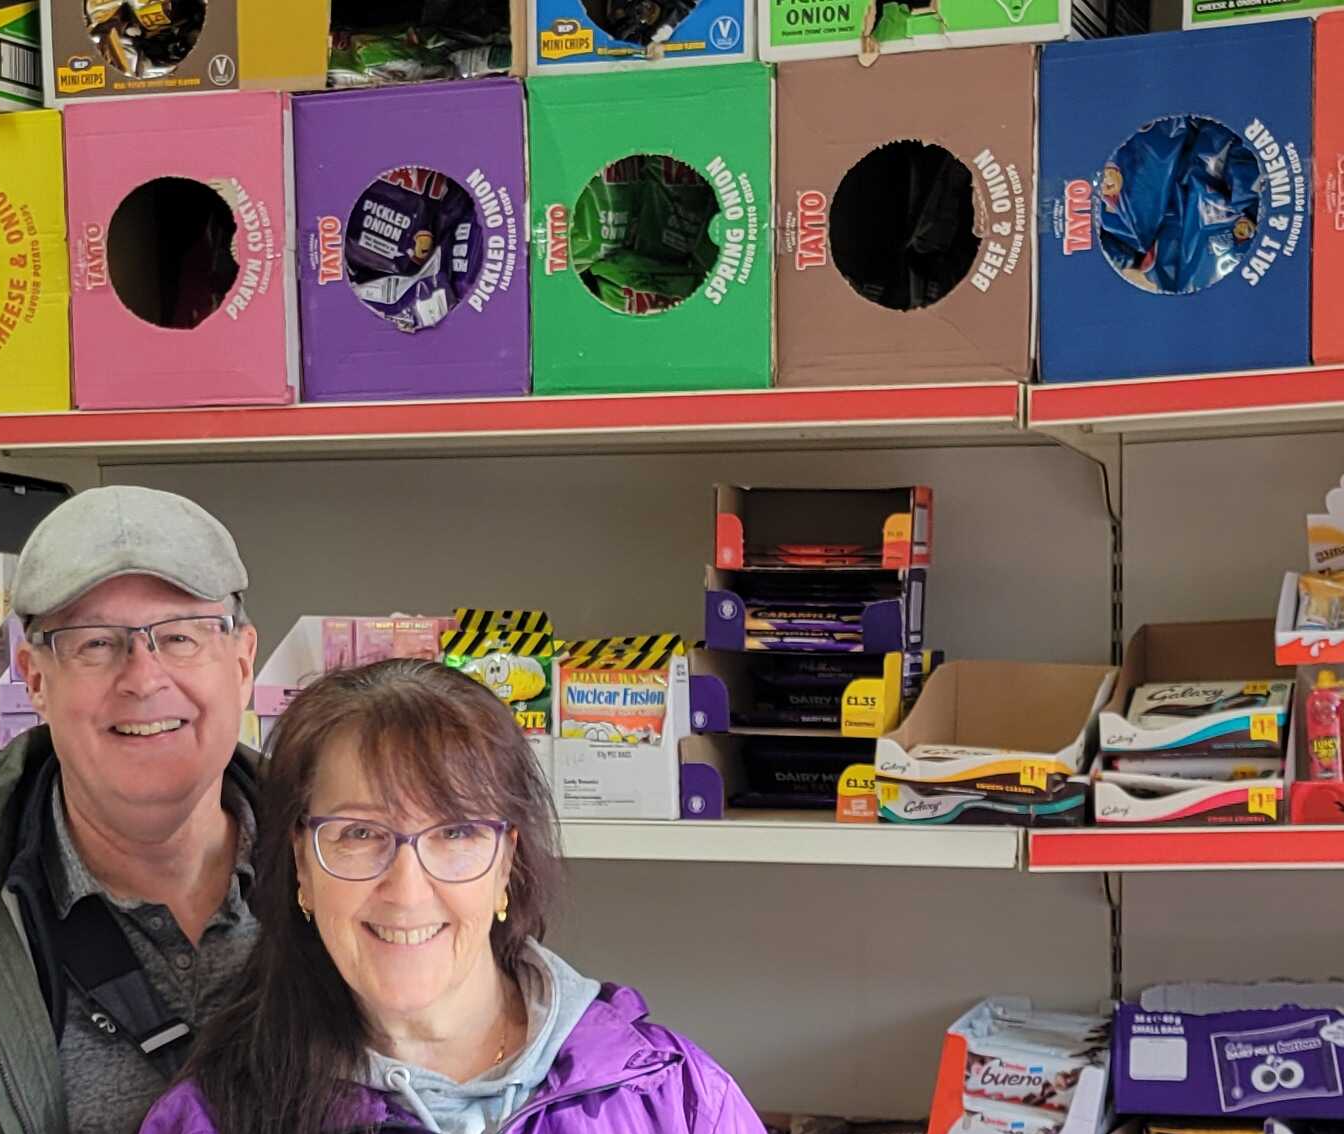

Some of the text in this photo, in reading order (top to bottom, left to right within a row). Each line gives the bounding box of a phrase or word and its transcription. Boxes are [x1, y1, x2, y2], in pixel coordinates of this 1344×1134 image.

[786, 3, 850, 27] ONION
[973, 148, 1012, 214] ONION
[1244, 118, 1292, 209] VINEGAR
[362, 200, 411, 230] PICKLED
[362, 216, 403, 242] ONION
[465, 168, 506, 313] PICKLED ONION
[545, 203, 569, 276] TAYTO
[705, 156, 745, 305] SPRING ONION
[796, 190, 827, 271] TAYTO
[1063, 179, 1093, 256] TAYTO
[85, 222, 106, 290] TAYTO
[318, 215, 343, 286] TAYTO
[970, 240, 1008, 293] BEEF
[1241, 235, 1281, 287] SALT
[225, 258, 262, 321] PRAWN
[566, 687, 622, 706] Nuclear
[980, 1062, 1043, 1088] bueno
